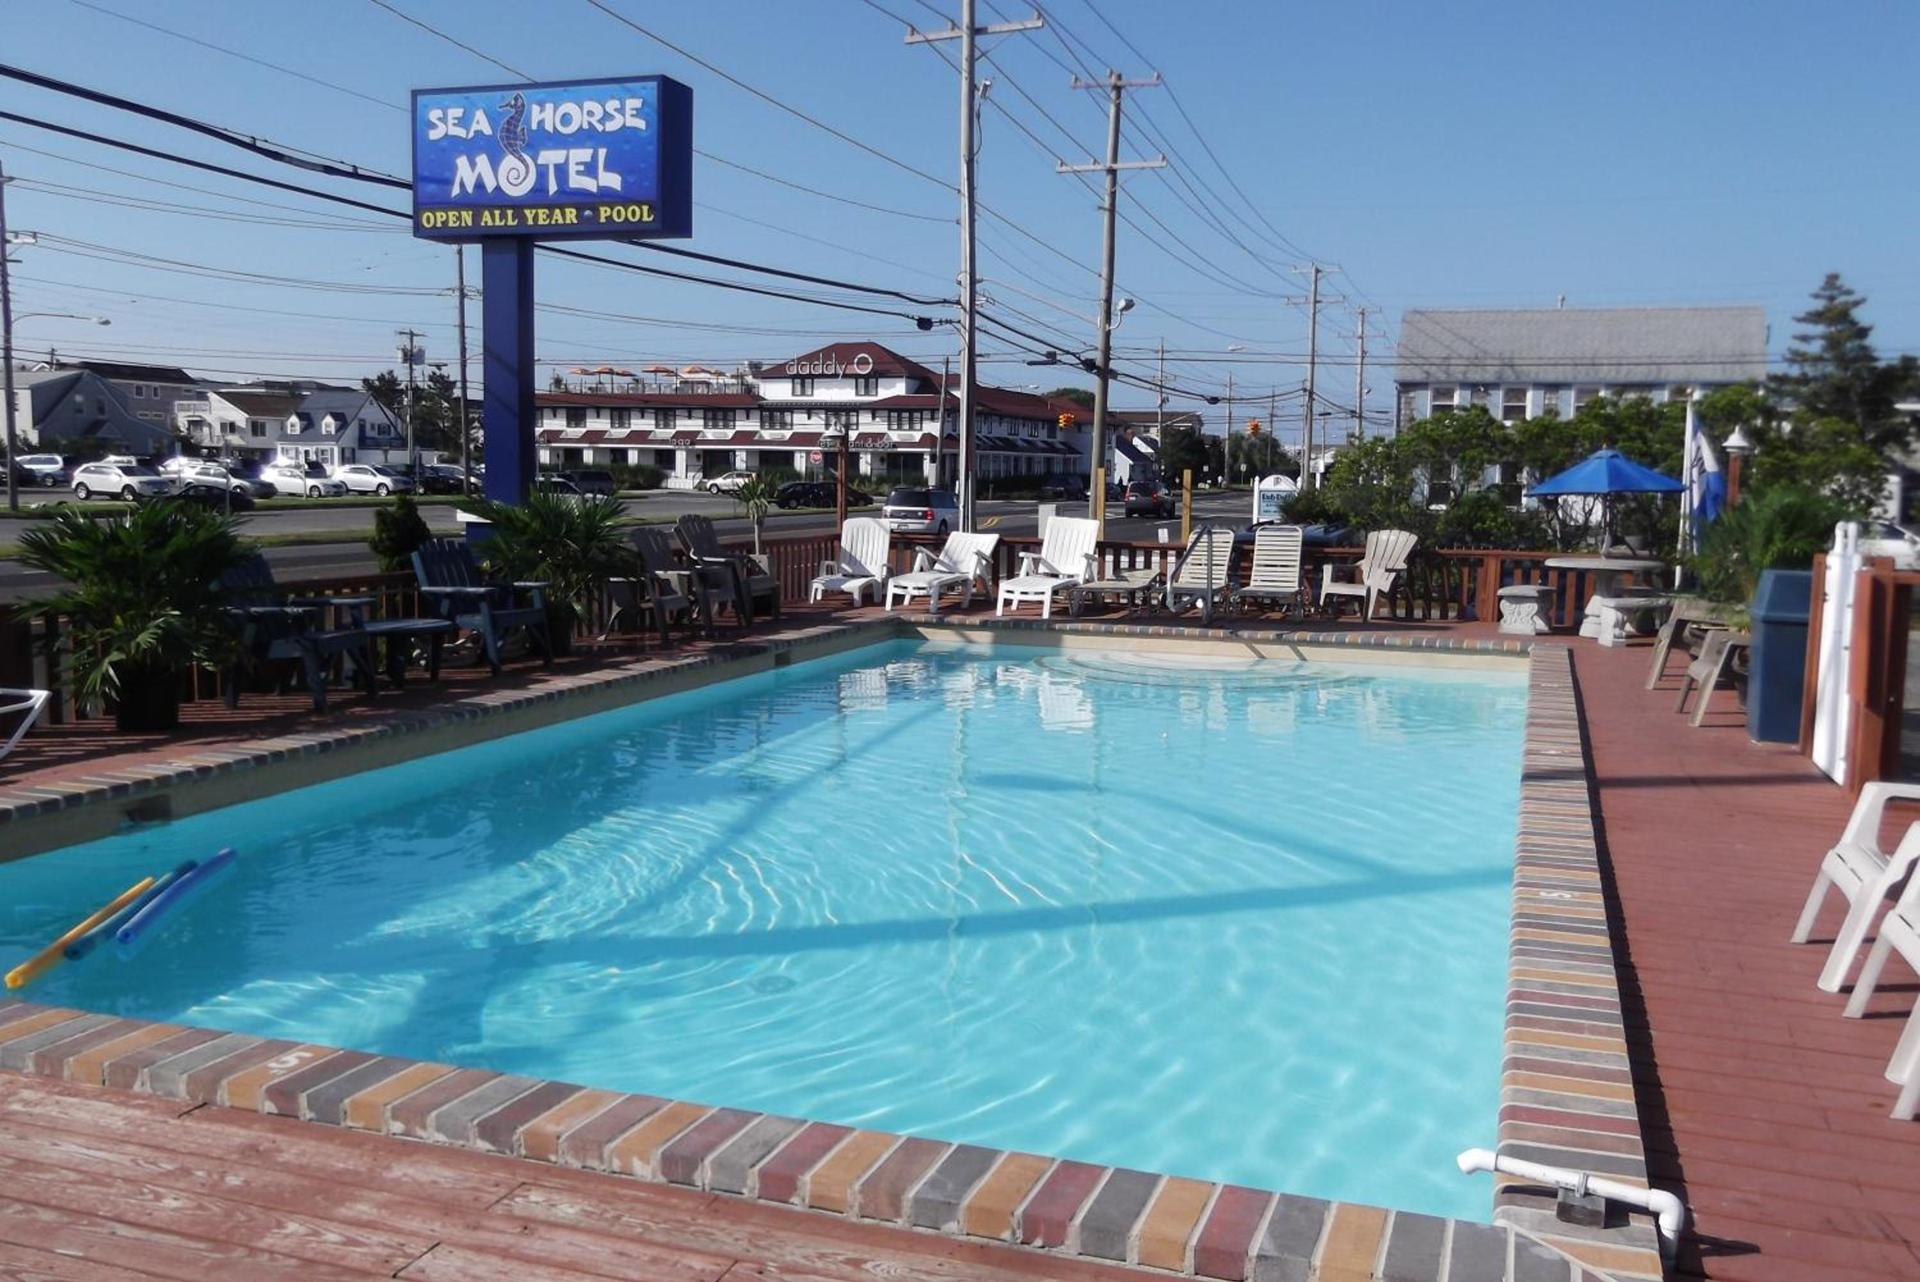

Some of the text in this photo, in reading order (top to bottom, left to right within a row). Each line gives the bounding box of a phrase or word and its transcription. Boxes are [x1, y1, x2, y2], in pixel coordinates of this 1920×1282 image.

[428, 98, 647, 141] SEA HORSE
[451, 148, 622, 198] MOTEL
[422, 204, 655, 228] OPEN ALL YEAR POOL
[785, 352, 873, 380] daddy O
